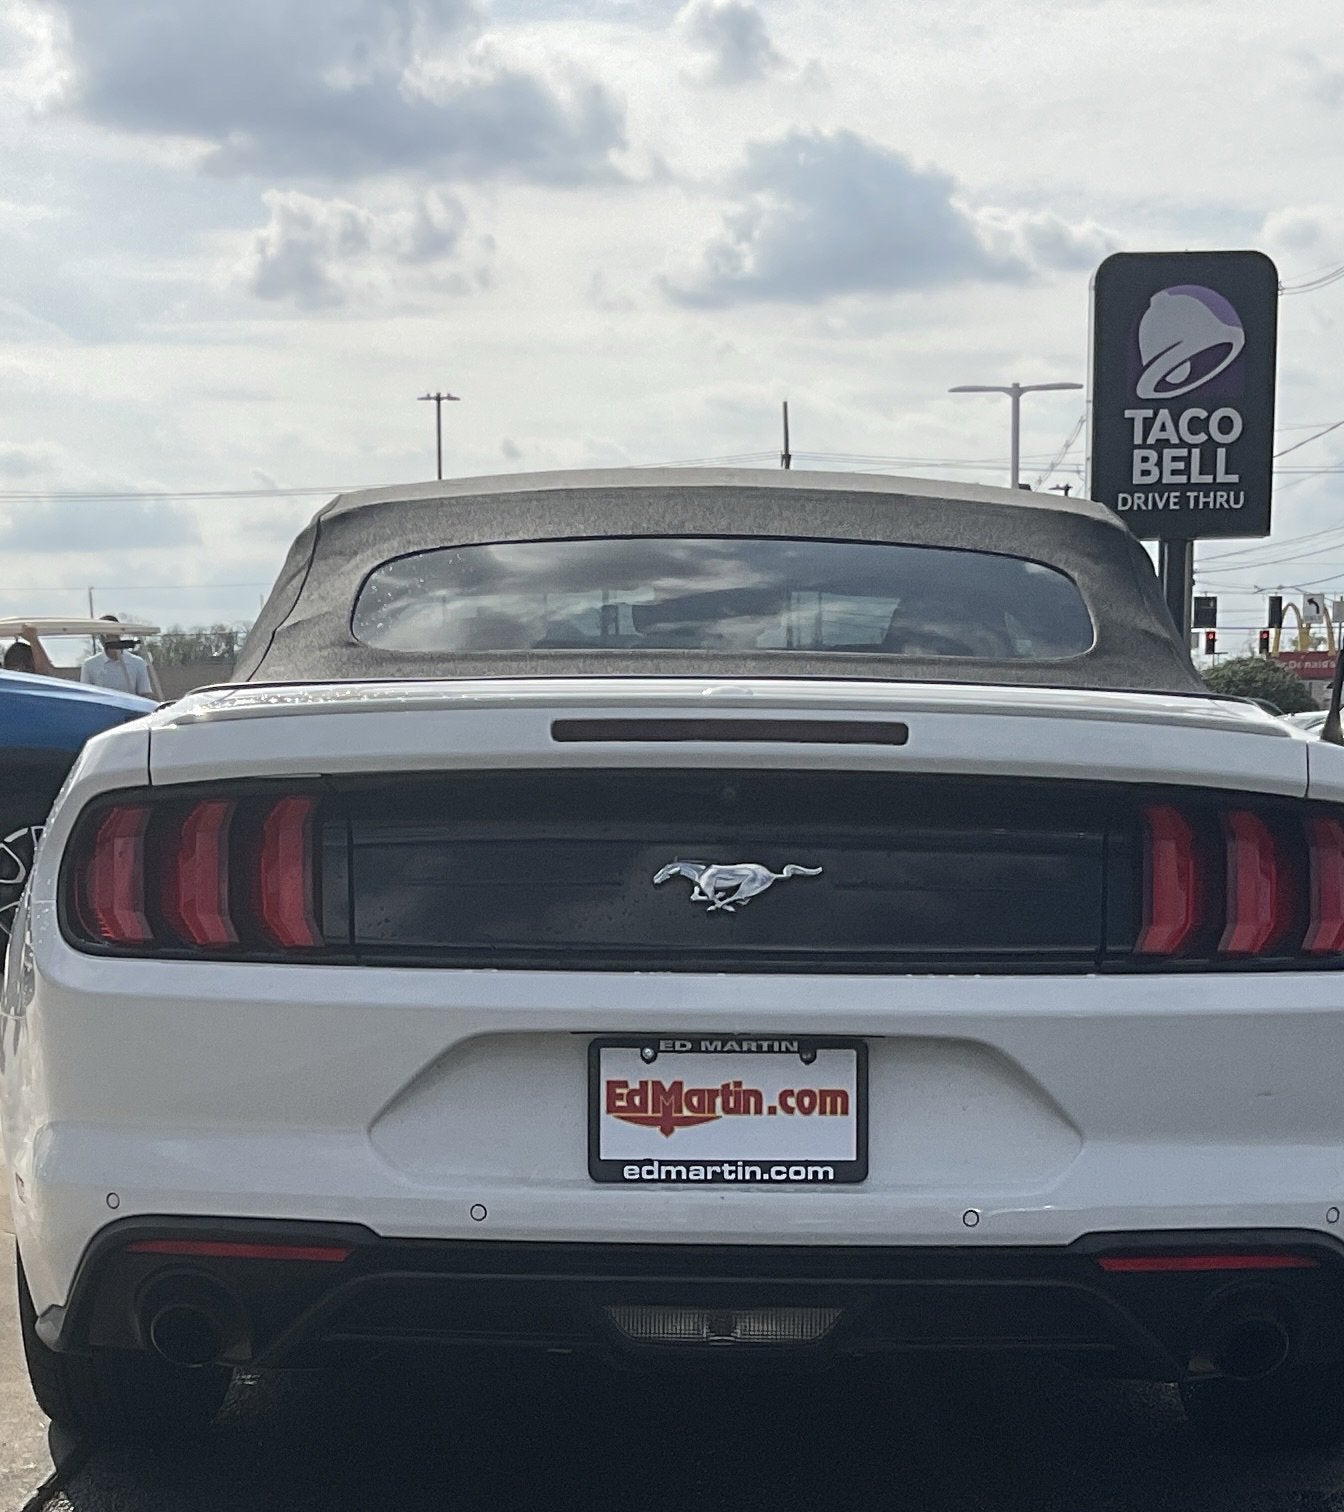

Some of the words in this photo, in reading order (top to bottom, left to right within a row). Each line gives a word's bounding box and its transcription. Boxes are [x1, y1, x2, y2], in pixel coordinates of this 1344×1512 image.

[1123, 406, 1244, 446] TACO
[1131, 447, 1240, 486] BELL
[1116, 492, 1181, 511] DRIVE
[1187, 490, 1246, 510] THRU
[658, 1039, 693, 1052] ED
[700, 1040, 799, 1052] MARTIN
[605, 1079, 850, 1126] EdMartin.com
[622, 1161, 835, 1181] edmartin.com
